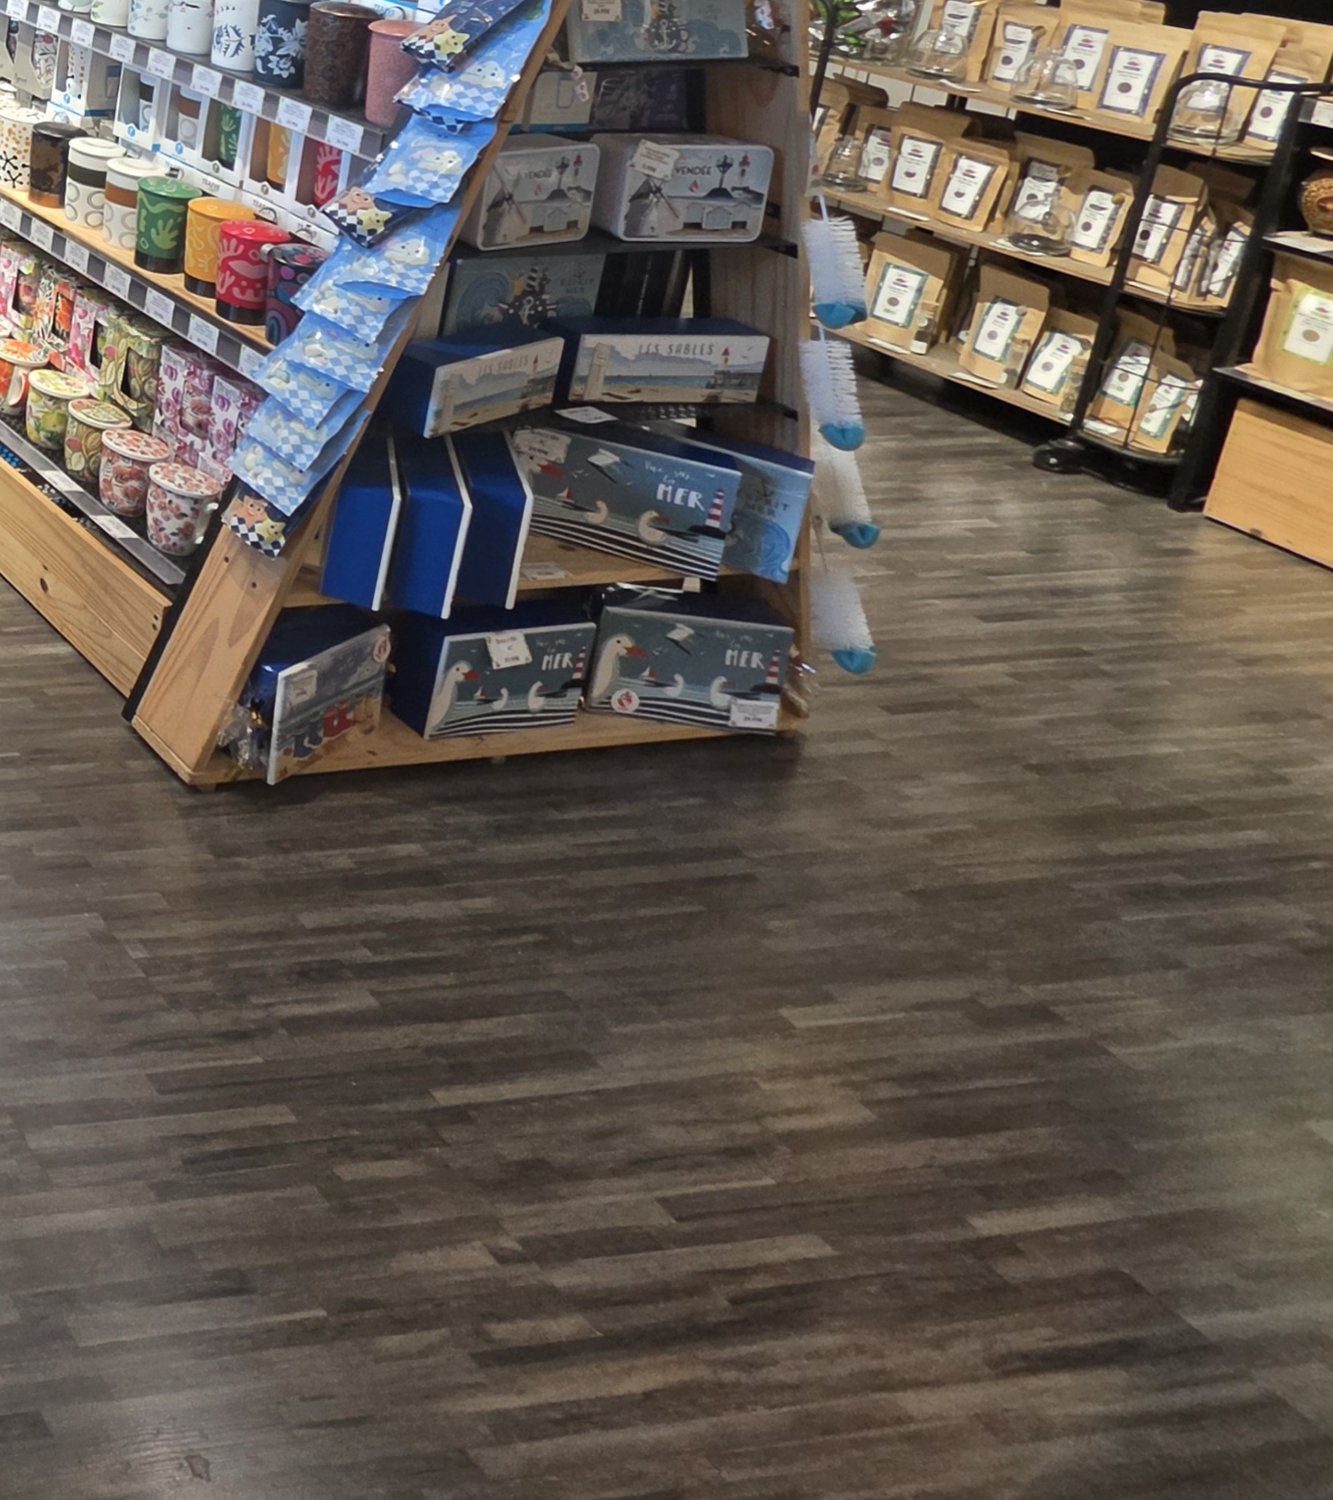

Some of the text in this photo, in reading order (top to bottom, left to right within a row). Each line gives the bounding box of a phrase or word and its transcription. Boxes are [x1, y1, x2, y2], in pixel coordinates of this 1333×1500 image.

[674, 165, 713, 176] VENDÉE
[638, 342, 715, 356] LES SABLES
[656, 483, 706, 512] MER
[541, 651, 574, 672] MER
[725, 648, 766, 670] MER
